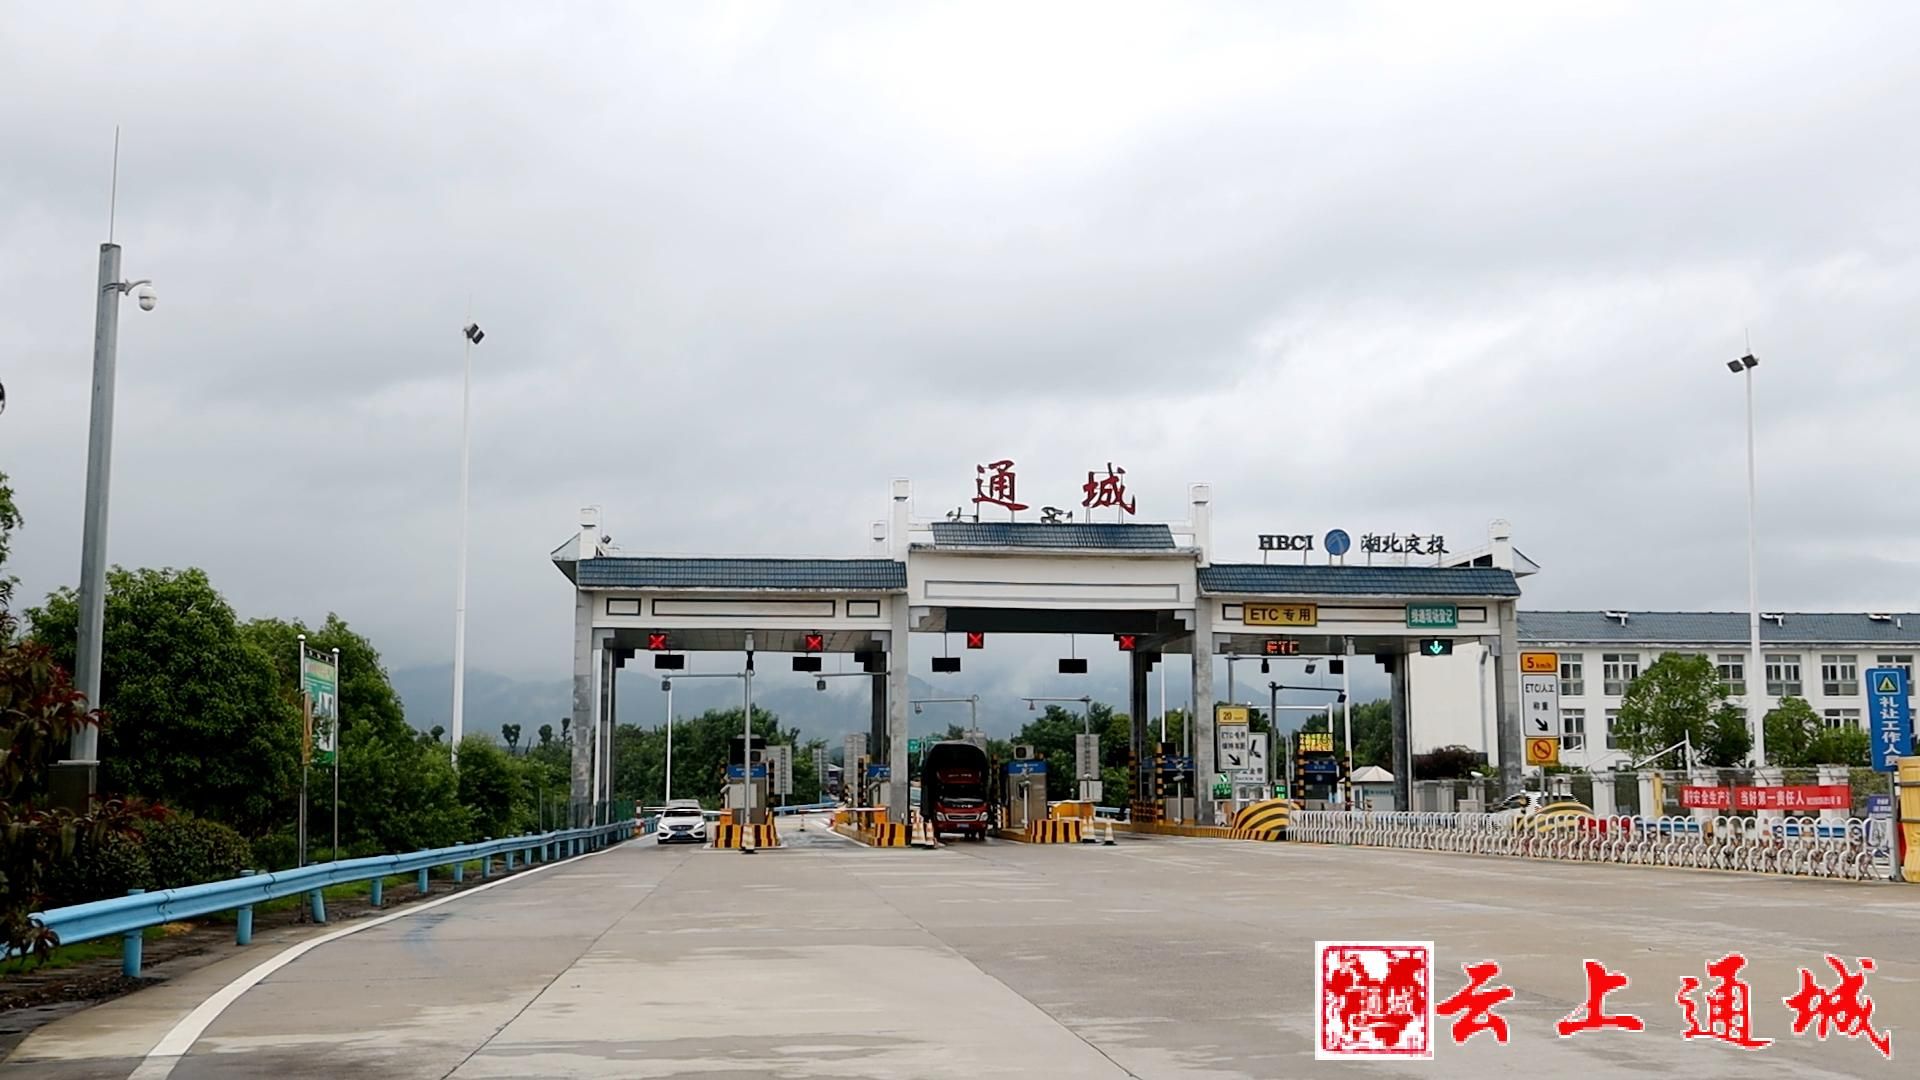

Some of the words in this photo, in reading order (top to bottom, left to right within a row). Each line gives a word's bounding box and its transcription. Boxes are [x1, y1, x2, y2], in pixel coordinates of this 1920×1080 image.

[971, 460, 1136, 516] 通城
[1258, 535, 1314, 551] HBCI
[1360, 532, 1450, 555] 湖北交投
[1250, 608, 1278, 621] ETC
[1283, 608, 1311, 622] 专用
[1267, 640, 1299, 654] ETC
[1527, 657, 1534, 669] 5
[1223, 712, 1232, 721] 20
[1740, 790, 1805, 807] 当好第一责任人
